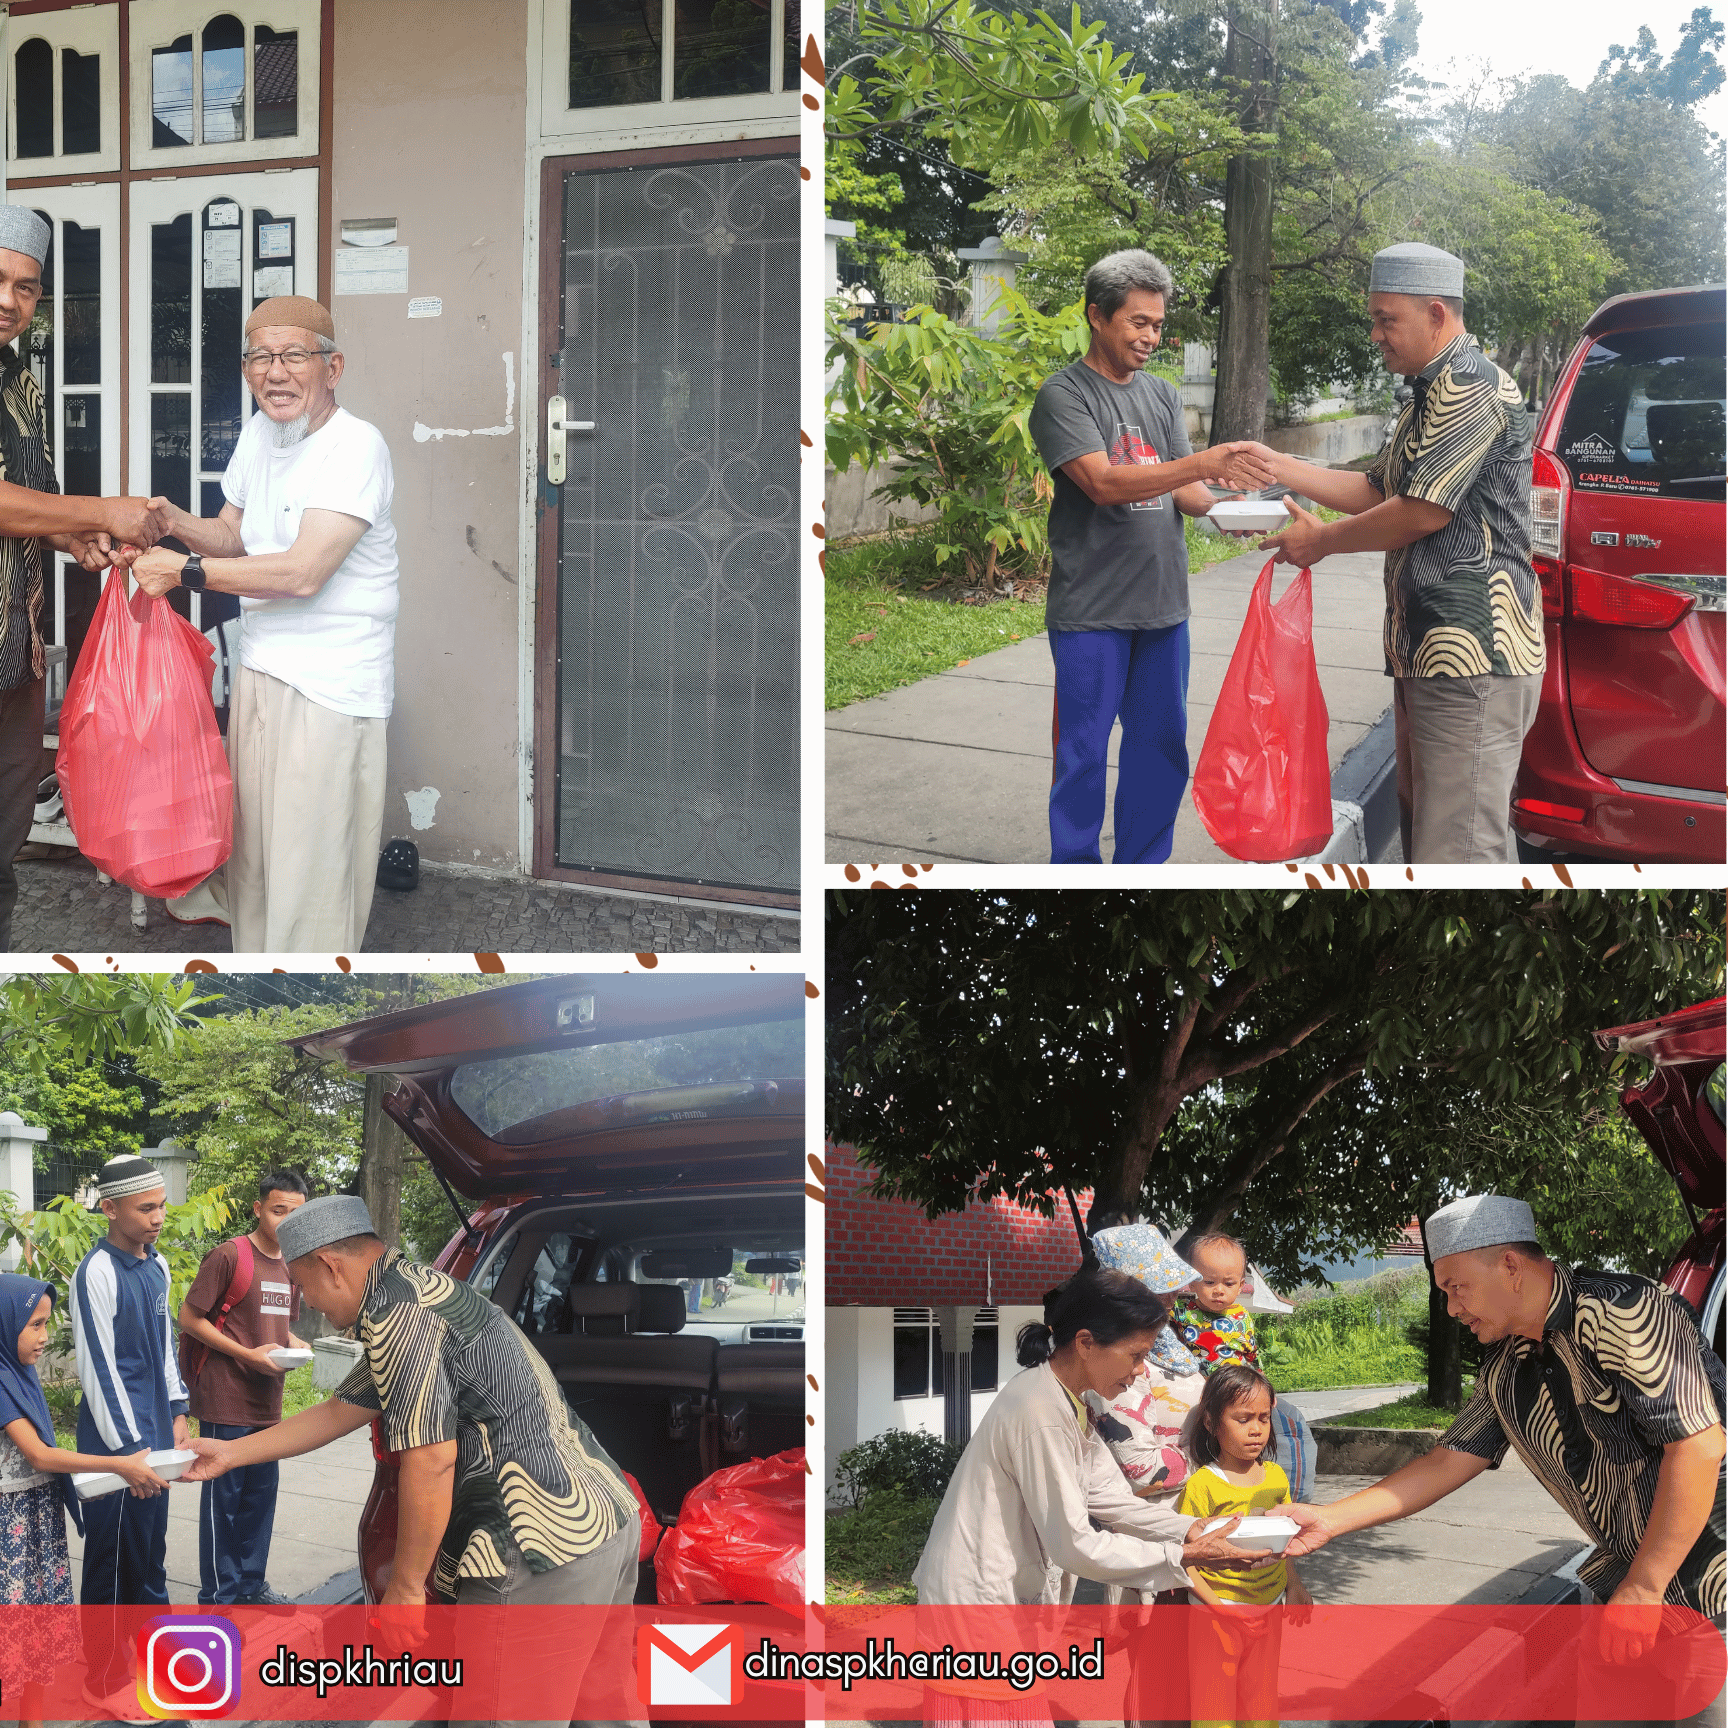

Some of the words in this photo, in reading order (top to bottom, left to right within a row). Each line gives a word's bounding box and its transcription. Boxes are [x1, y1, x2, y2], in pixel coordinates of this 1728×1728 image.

[1579, 473, 1629, 484] CAPELLA
[1630, 479, 1660, 487] DAIHATSU
[262, 1292, 291, 1306] HUGO
